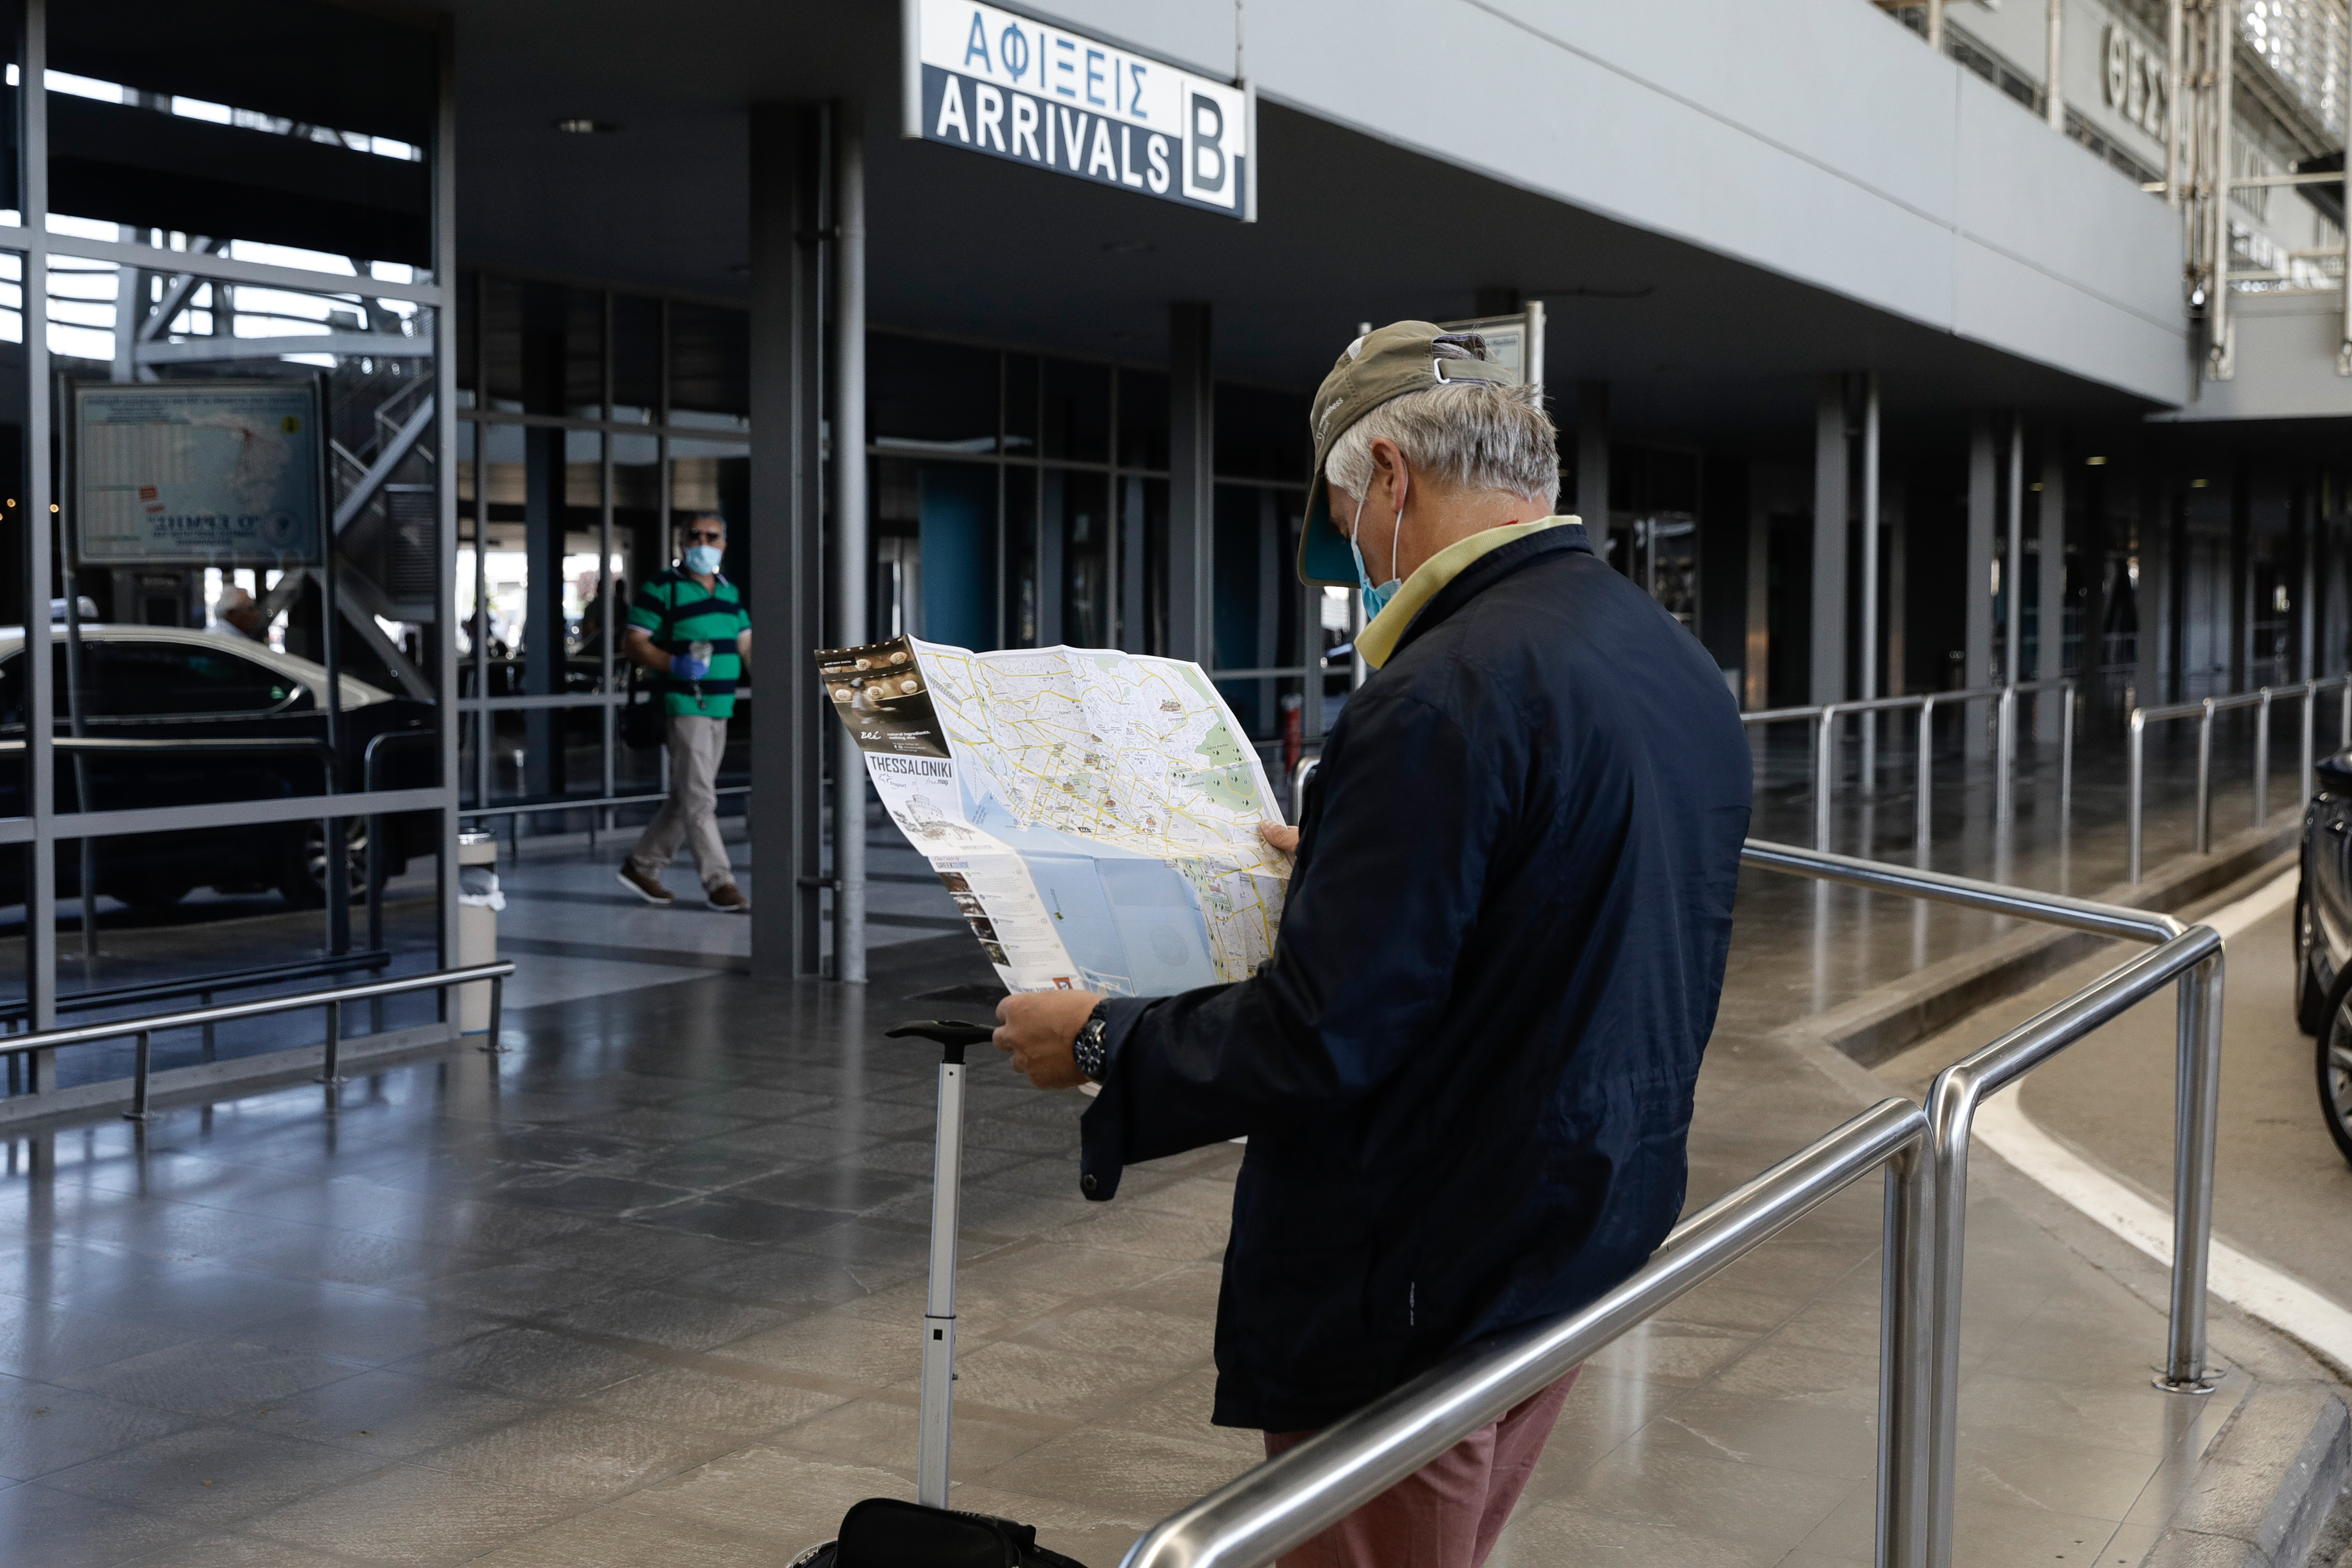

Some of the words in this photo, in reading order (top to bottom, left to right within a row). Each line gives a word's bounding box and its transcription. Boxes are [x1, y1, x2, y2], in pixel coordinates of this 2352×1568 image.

[964, 11, 1147, 119] ΑΦΙΞΕΙΣ
[937, 74, 1170, 195] ARRIVALS
[1192, 92, 1225, 193] B
[861, 731, 881, 740] Blé
[870, 756, 952, 778] THESSALONIKI
